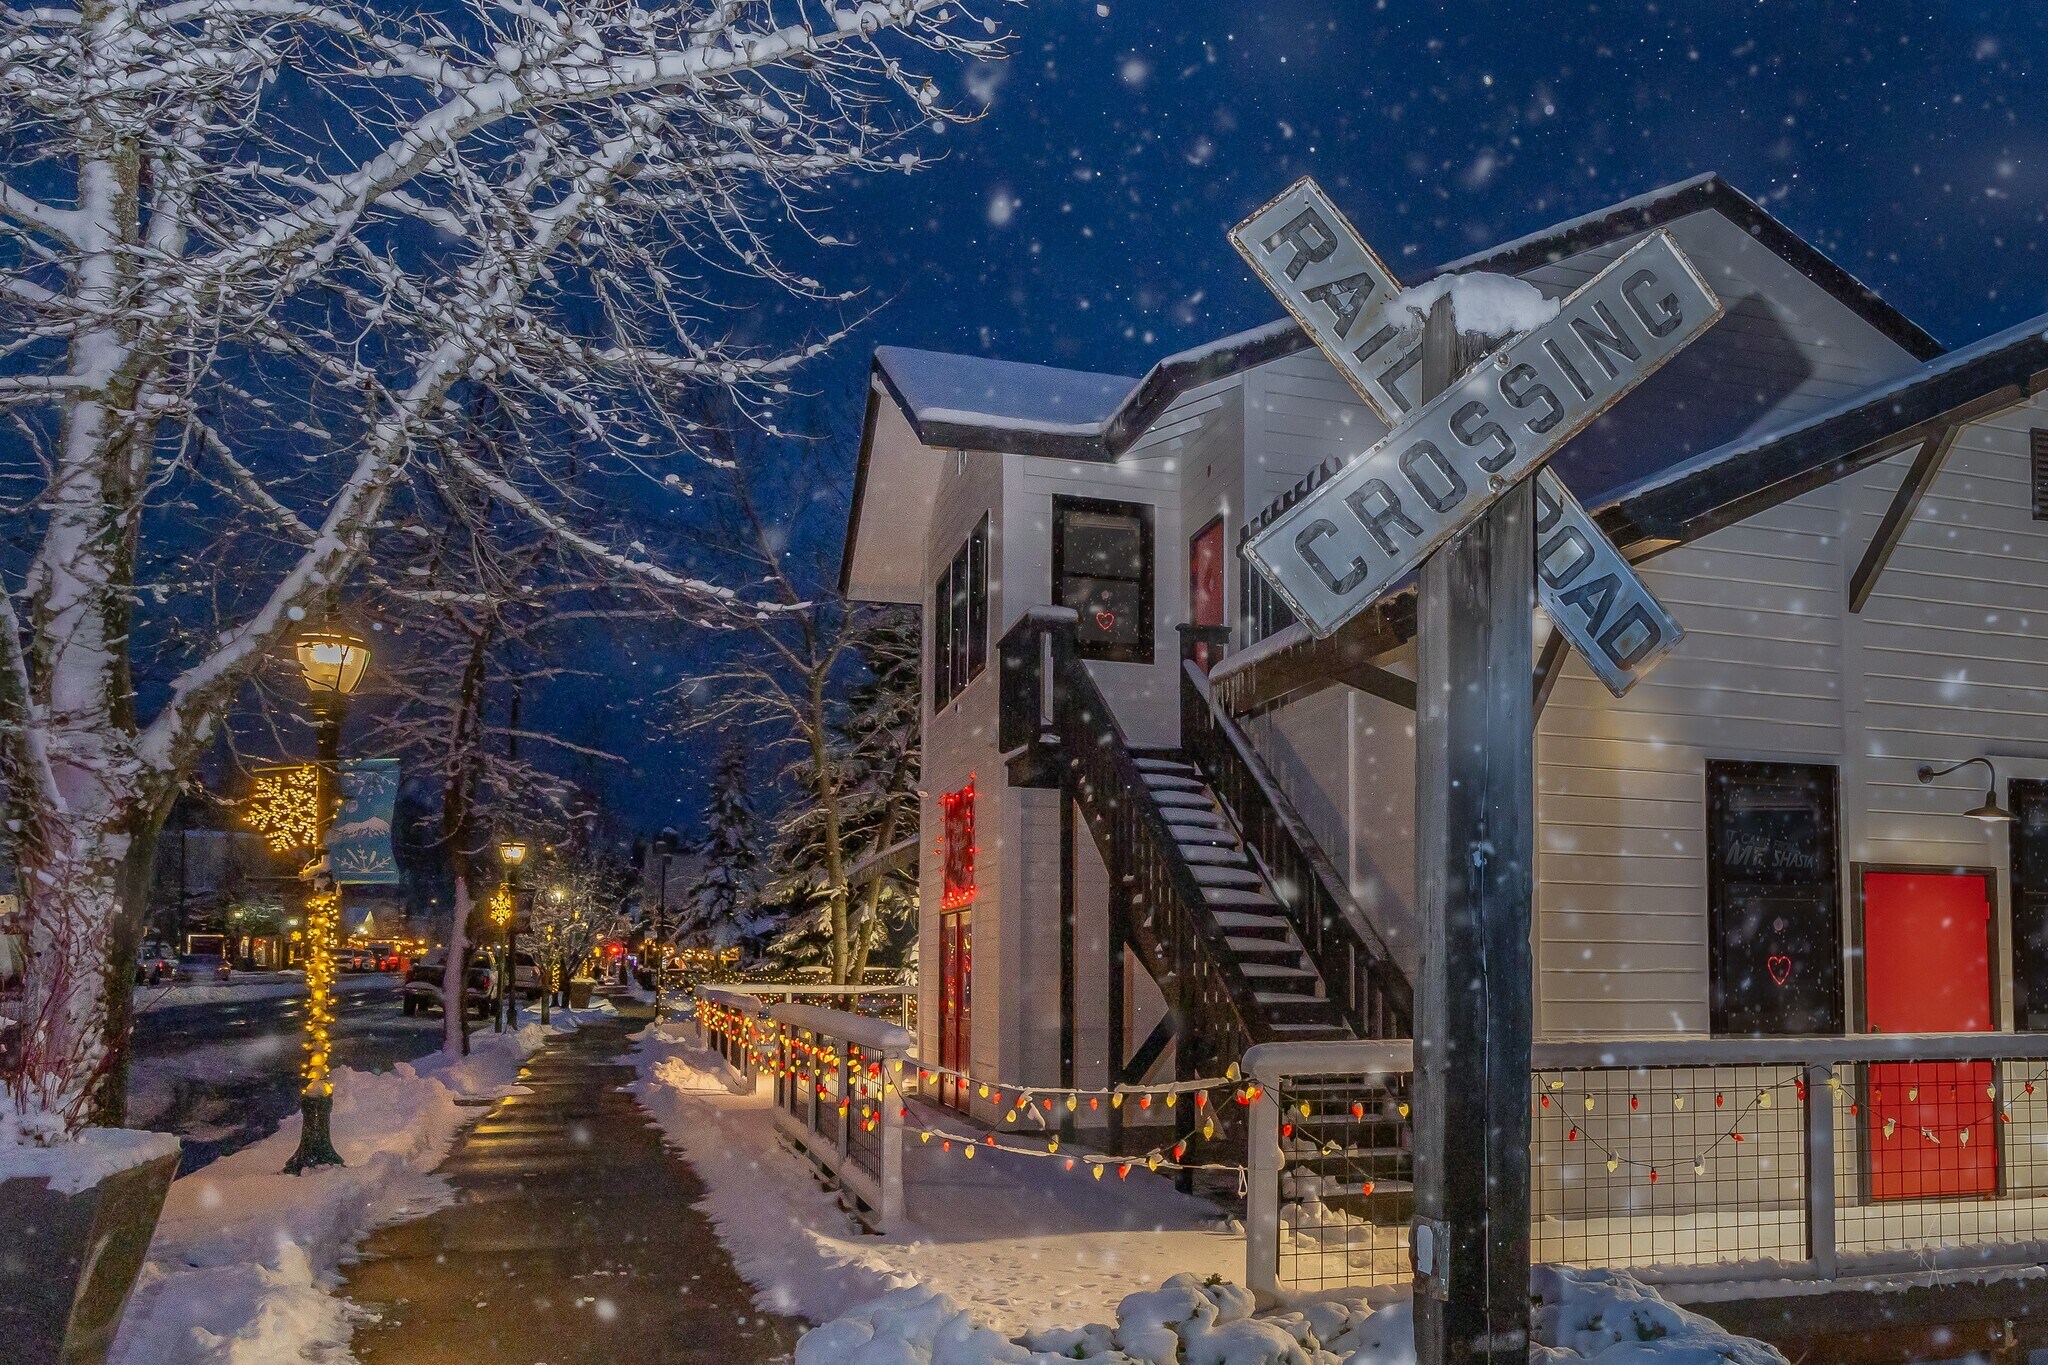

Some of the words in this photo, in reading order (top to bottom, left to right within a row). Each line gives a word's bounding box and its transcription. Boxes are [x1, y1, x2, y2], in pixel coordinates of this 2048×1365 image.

[1260, 206, 1423, 414] RAIL
[1295, 268, 1684, 596] CROSSING
[1771, 849, 1814, 868] SHASTA
